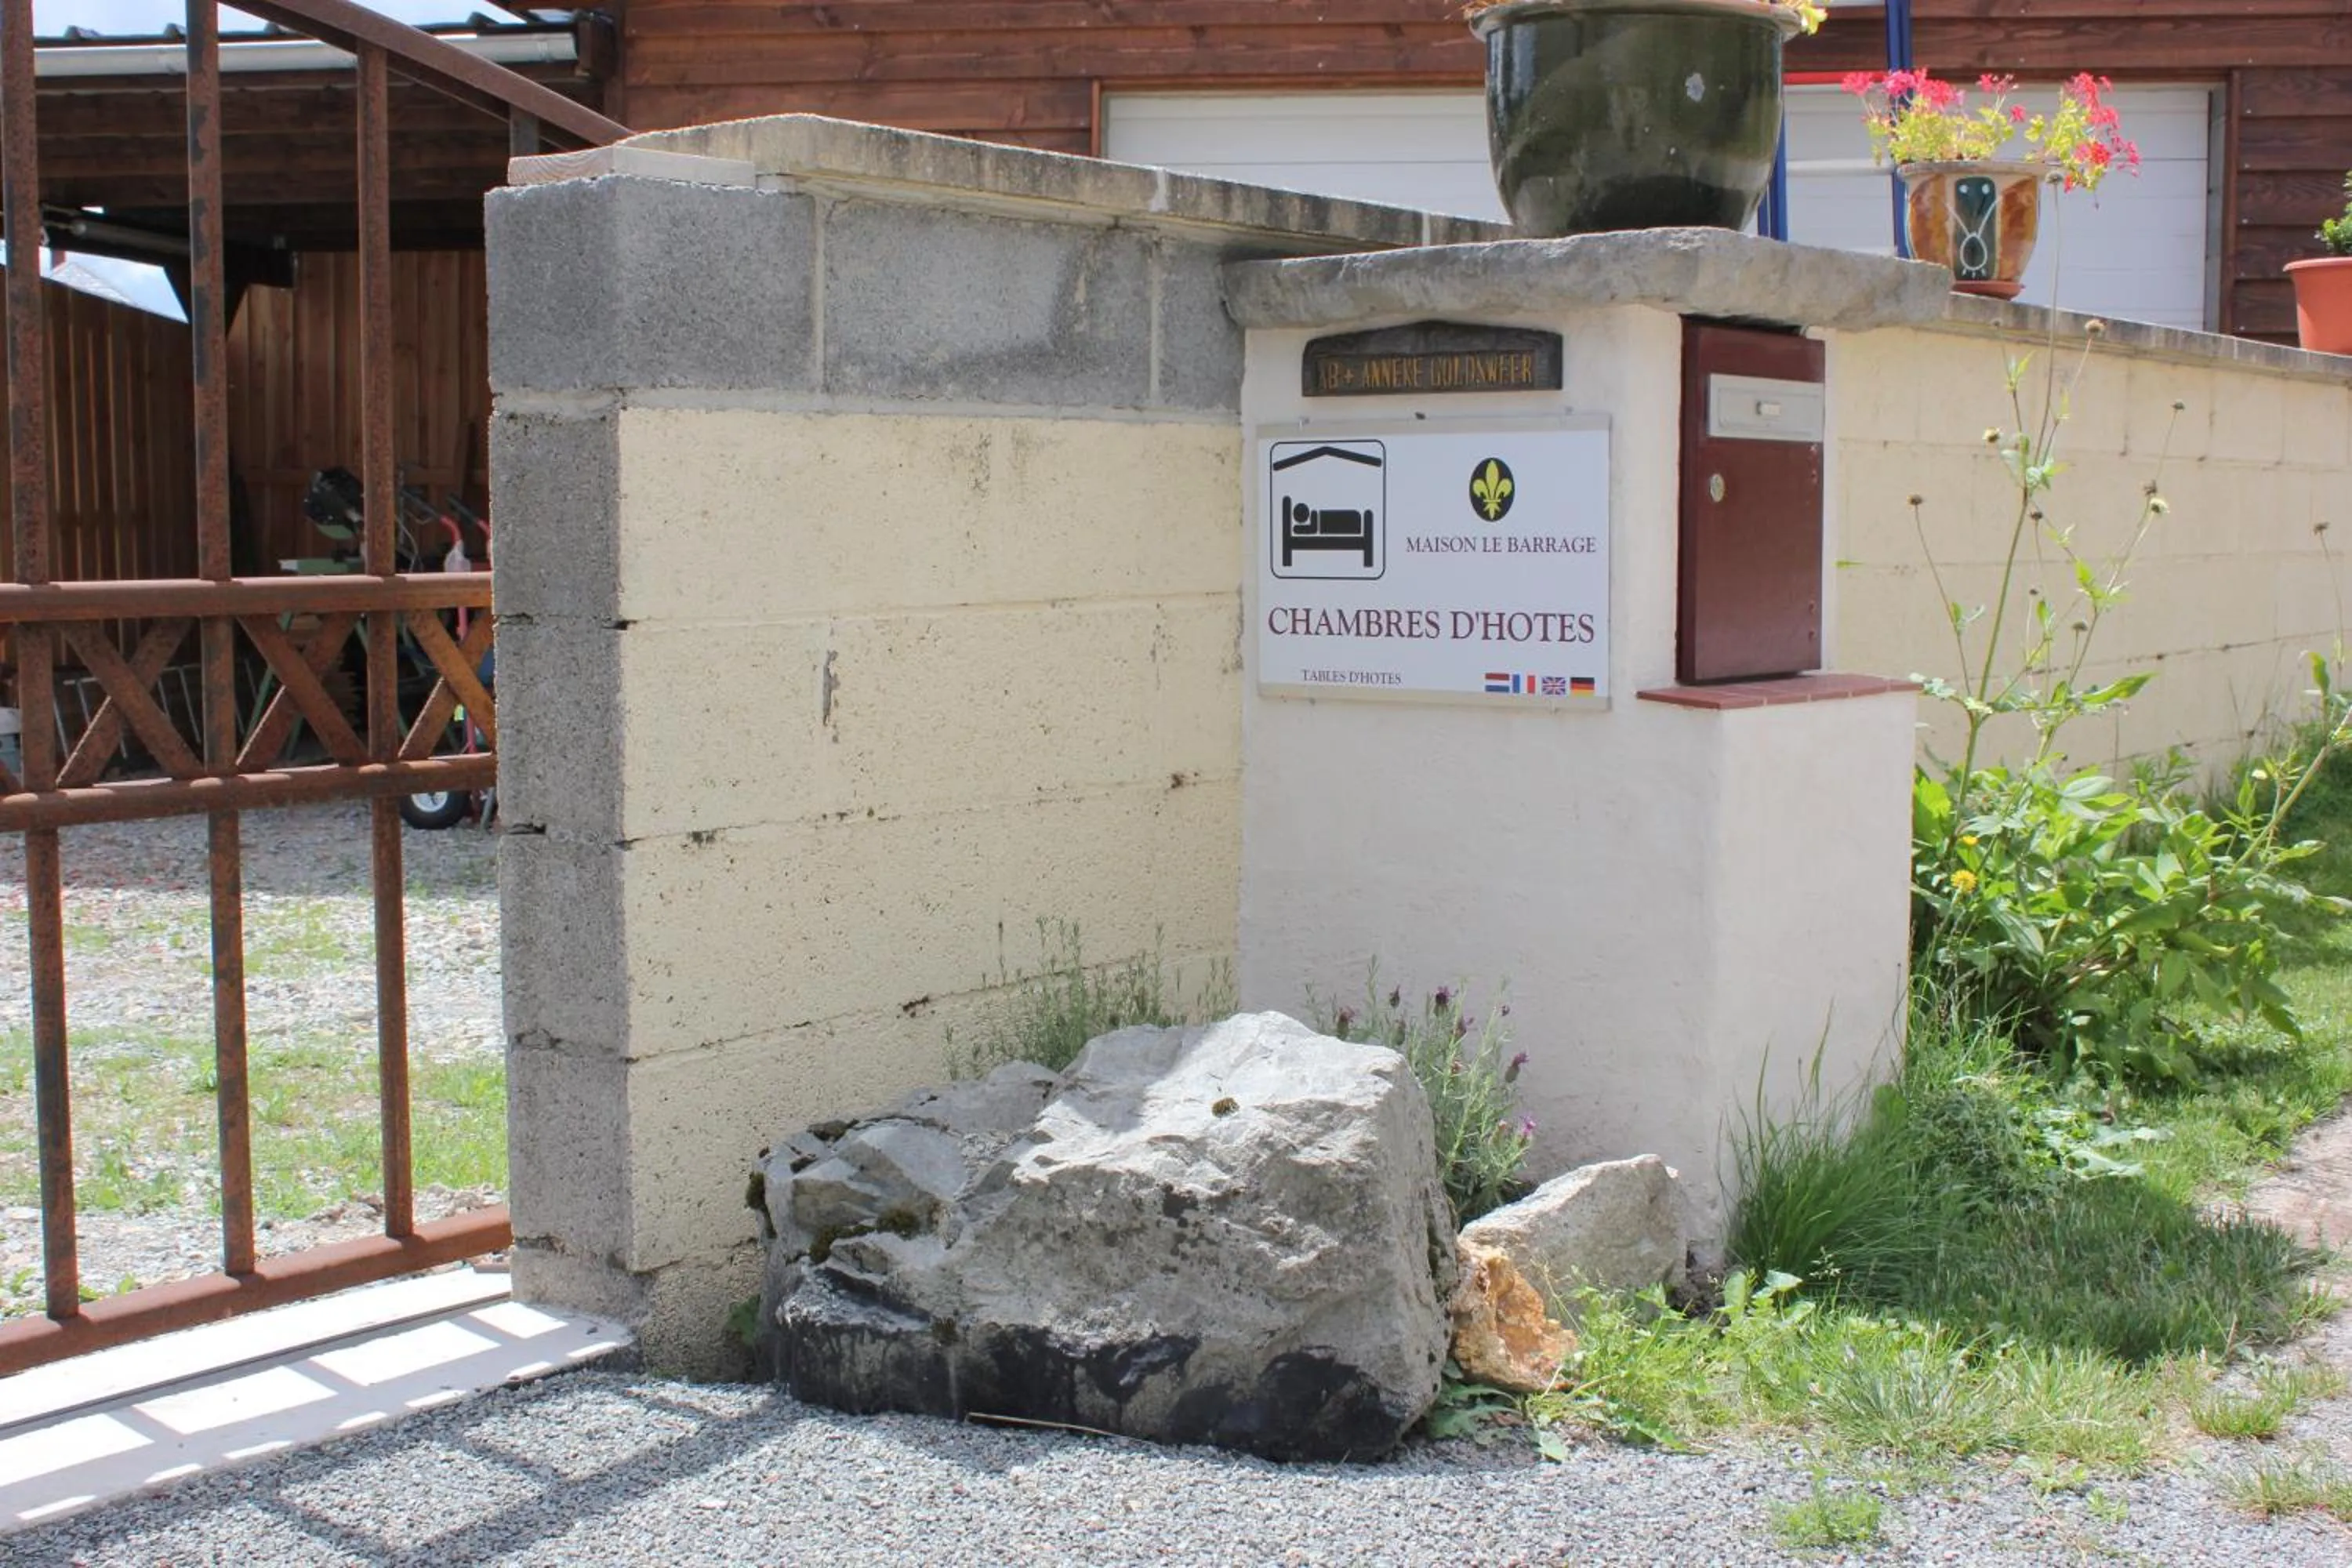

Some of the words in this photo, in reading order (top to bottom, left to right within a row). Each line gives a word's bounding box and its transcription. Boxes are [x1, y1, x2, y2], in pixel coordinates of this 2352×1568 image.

[1406, 536, 1477, 553] MAISON
[1482, 536, 1502, 553] LE
[1507, 536, 1596, 554] BARRAGE
[1268, 607, 1441, 639] CHAMBRES
[1449, 611, 1595, 643] D'HOTES
[1301, 669, 1346, 683] TABLES
[1348, 671, 1402, 685] D'HOTES
